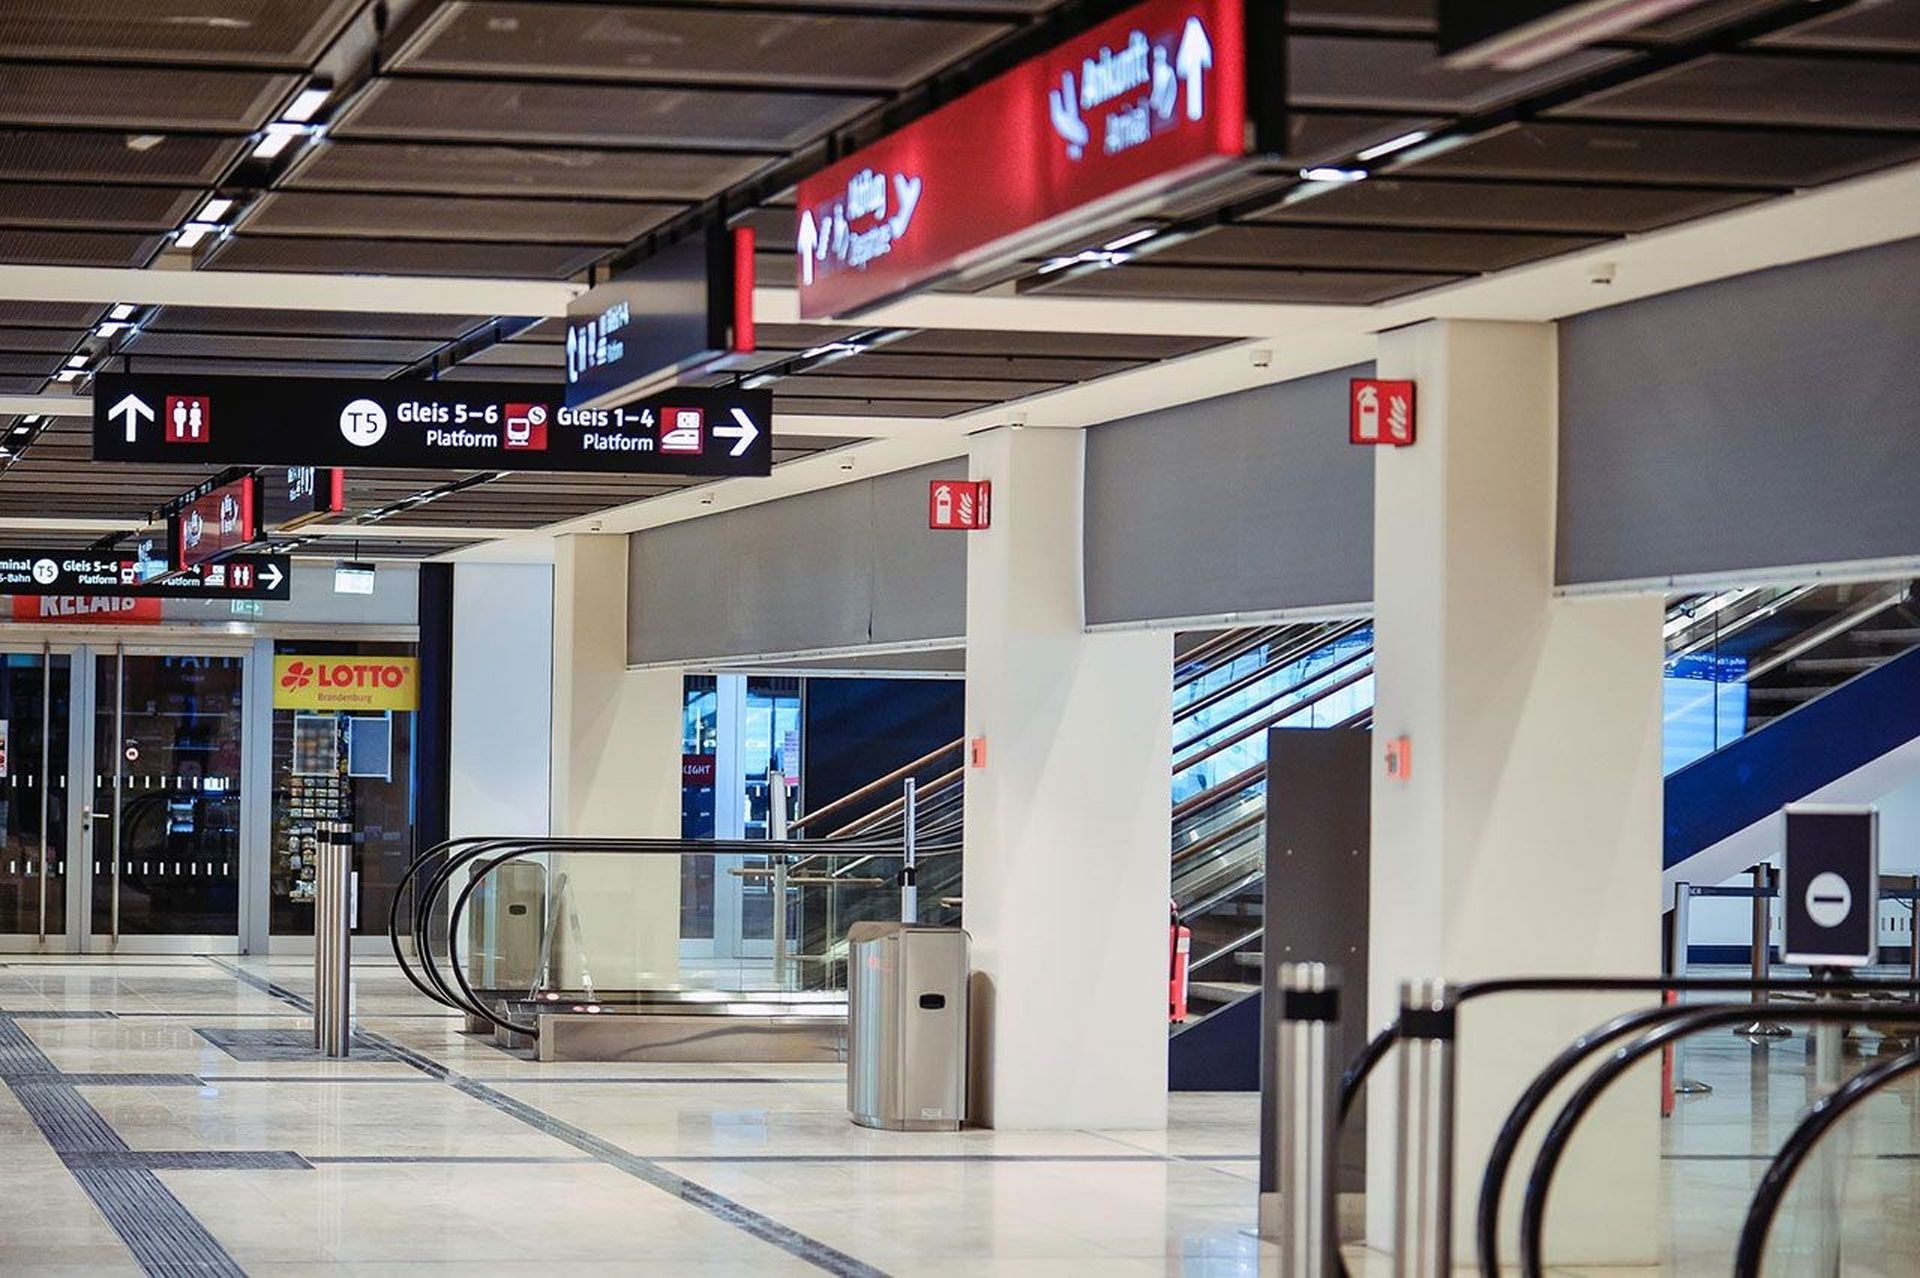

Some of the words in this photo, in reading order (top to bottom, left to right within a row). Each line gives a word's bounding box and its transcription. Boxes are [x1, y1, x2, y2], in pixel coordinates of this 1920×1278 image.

[397, 402, 449, 423] Gleis
[557, 406, 609, 426] Gleis
[347, 412, 378, 434] T5
[426, 430, 498, 448] Platform
[583, 433, 654, 451] Platform
[62, 560, 92, 573] Gleis
[78, 574, 118, 585] Platform
[318, 664, 404, 688] LOTTO
[317, 692, 372, 703] Brandenburg
